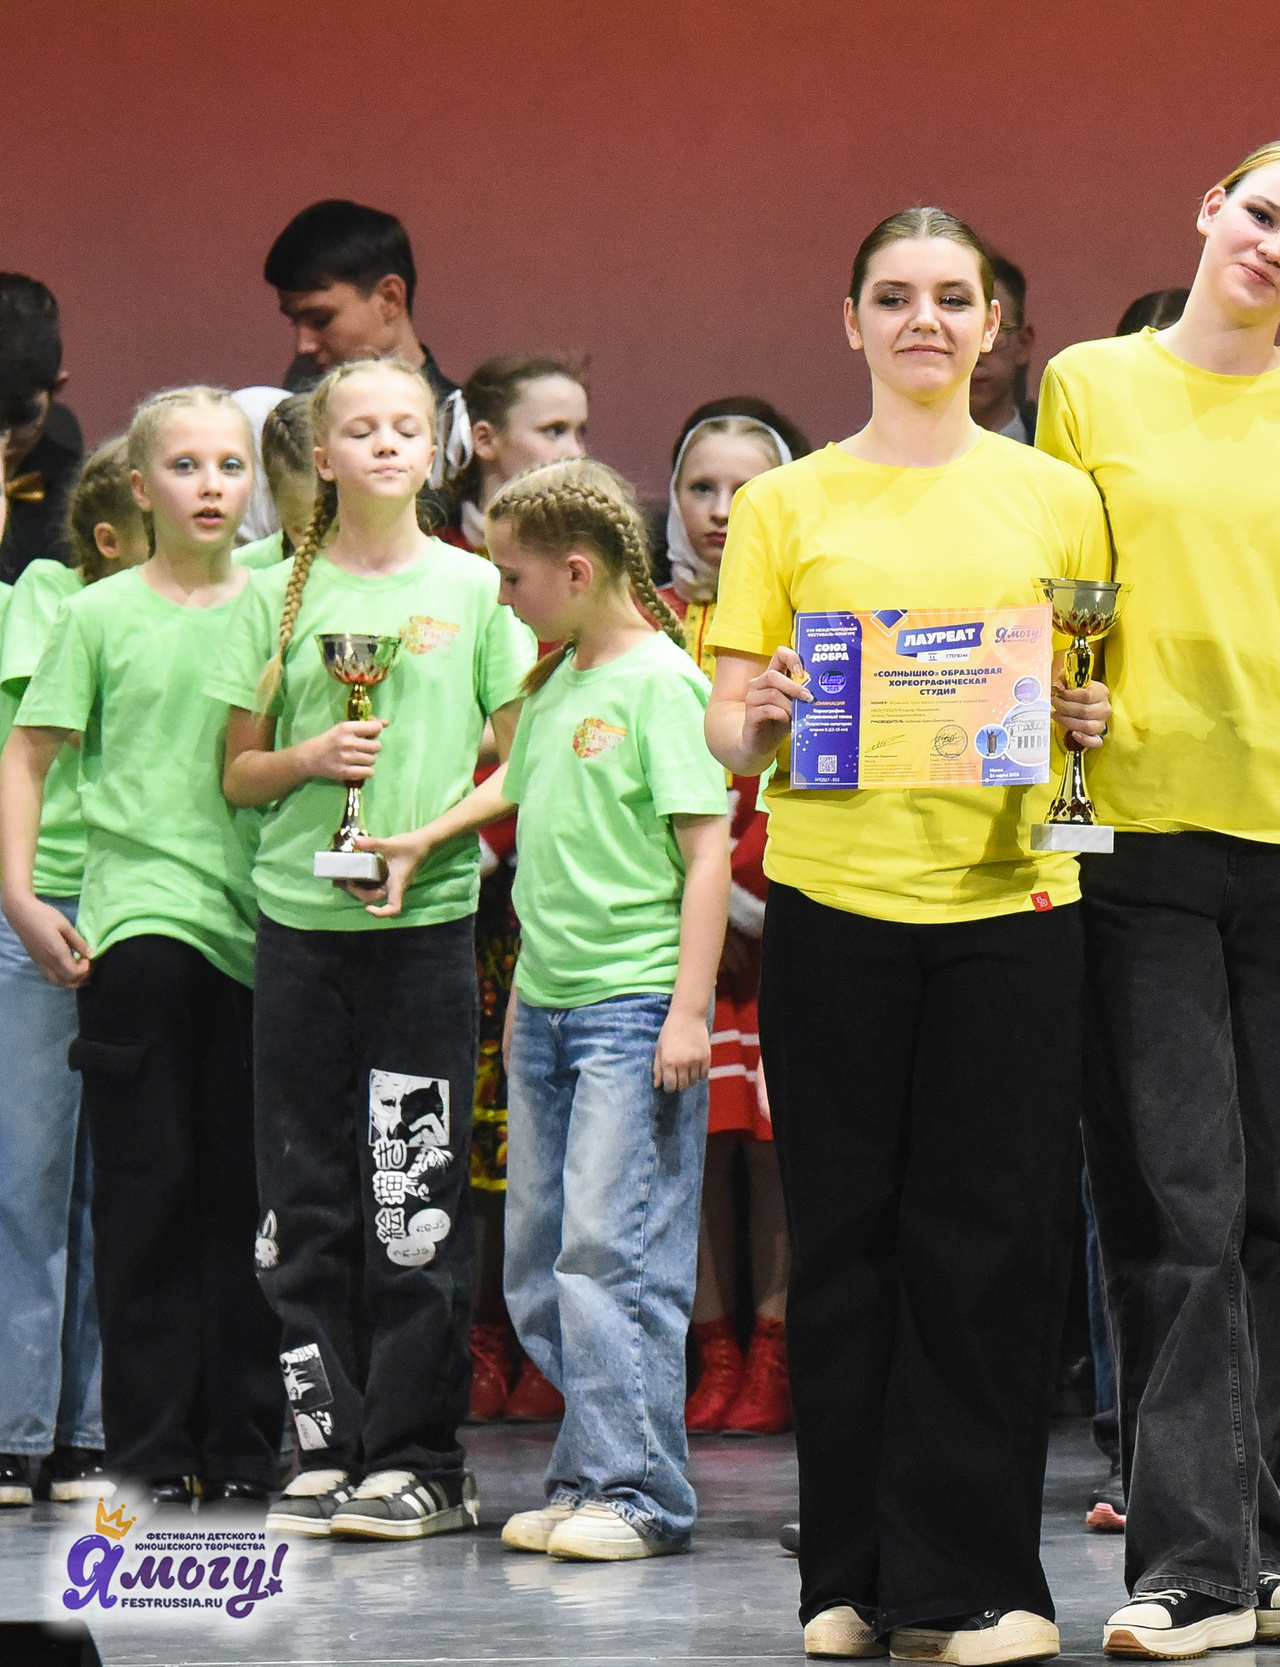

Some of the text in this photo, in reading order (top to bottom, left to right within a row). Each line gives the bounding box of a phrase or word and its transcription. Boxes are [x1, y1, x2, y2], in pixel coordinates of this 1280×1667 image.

[904, 628, 976, 647] ЛАУРЕАТ
[814, 643, 848, 652] СОЮЗ
[811, 652, 849, 662] ДОБРА
[873, 668, 1003, 678] «СОЛНЫШКО» ОБРАЗЦОВАЯ
[889, 678, 987, 686] ХОРЕОГРАФИЧЕСКАЯ
[919, 688, 956, 696] СТУДИЯ
